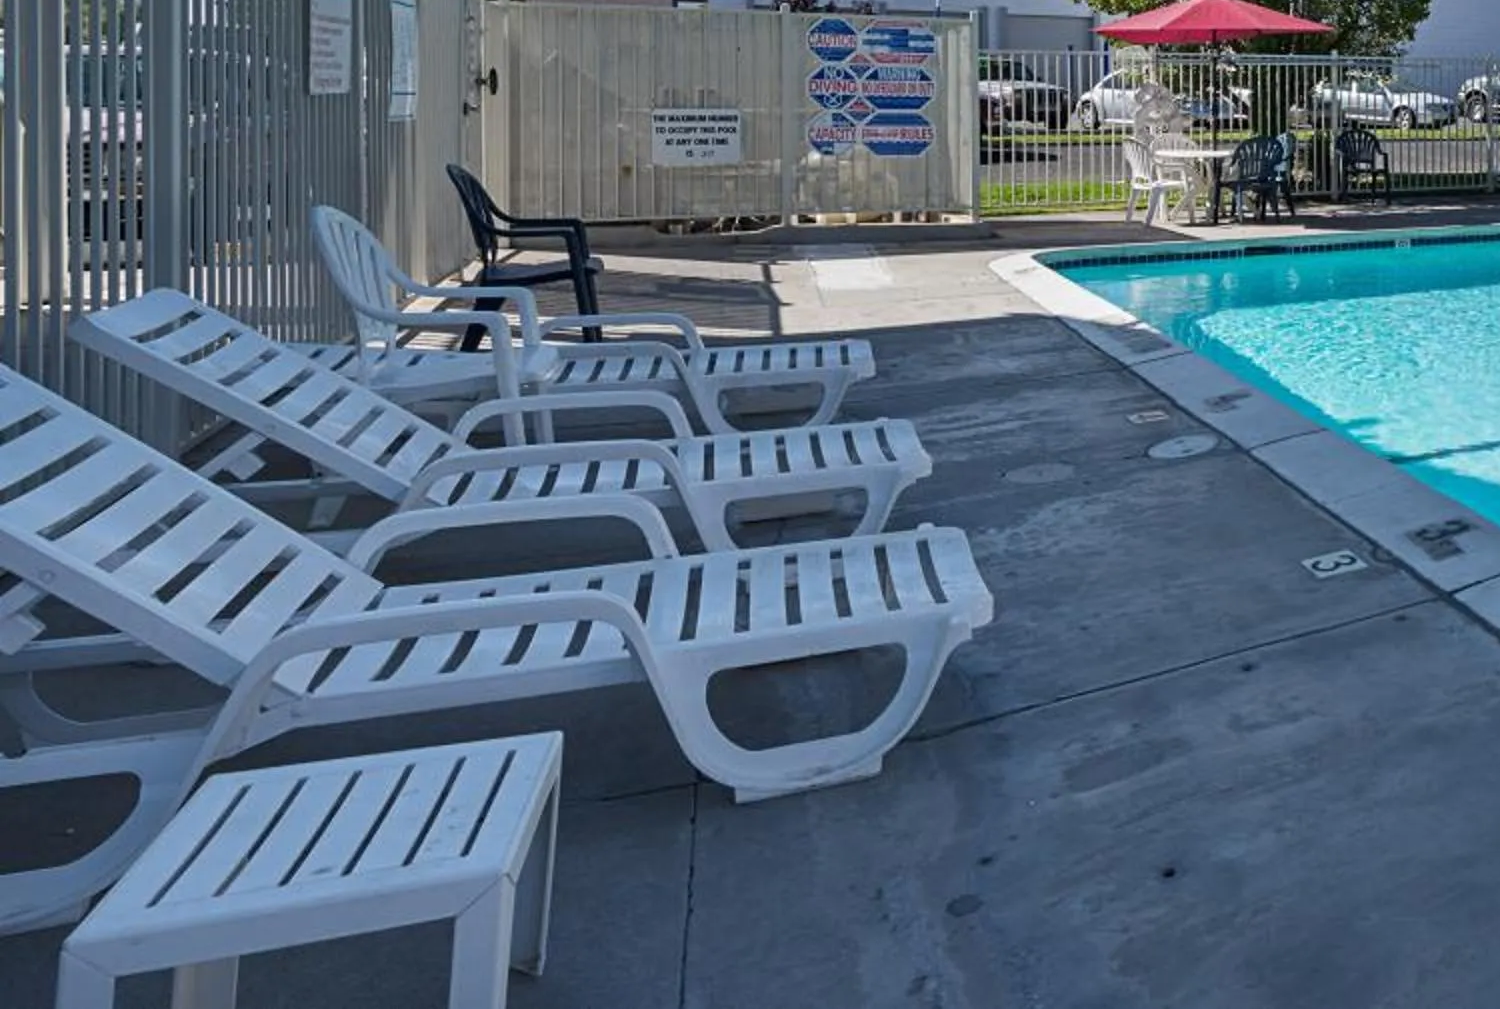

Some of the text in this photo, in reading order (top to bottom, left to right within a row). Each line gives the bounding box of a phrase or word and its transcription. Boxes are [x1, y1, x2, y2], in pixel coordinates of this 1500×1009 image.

[824, 65, 845, 80] NO
[809, 81, 857, 93] DIVING
[1312, 554, 1357, 572] 3
